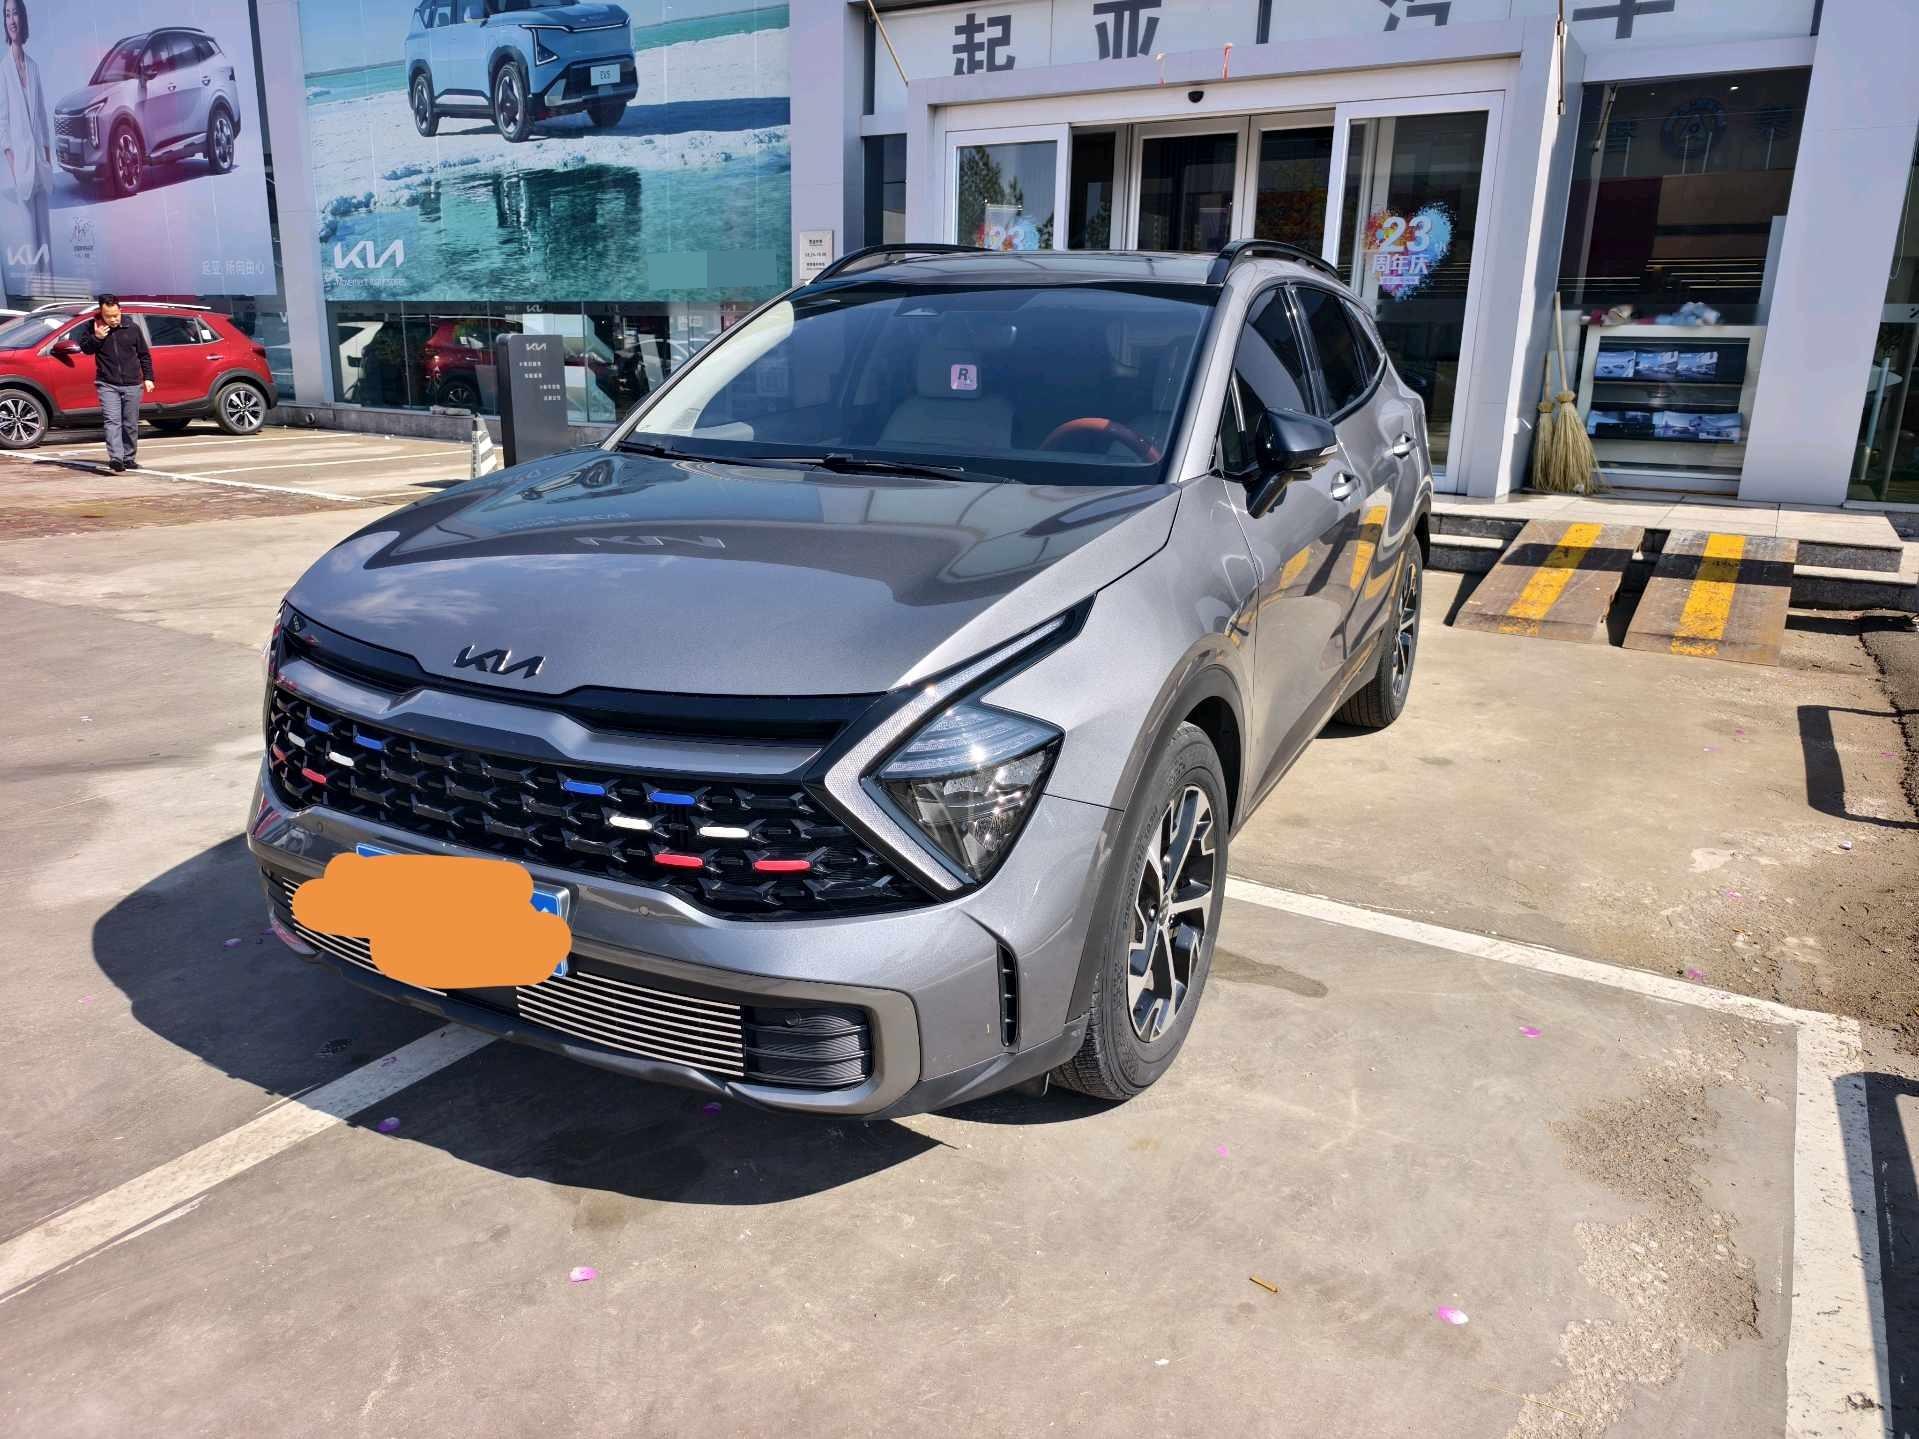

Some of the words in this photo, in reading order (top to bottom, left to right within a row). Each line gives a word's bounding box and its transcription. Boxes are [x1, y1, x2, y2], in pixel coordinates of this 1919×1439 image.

[1379, 216, 1431, 253] 23
[334, 239, 404, 269] KIA
[1372, 253, 1428, 274] 周年庆
[525, 342, 547, 351] KIA
[958, 367, 969, 380] R
[453, 644, 546, 679] KIA
